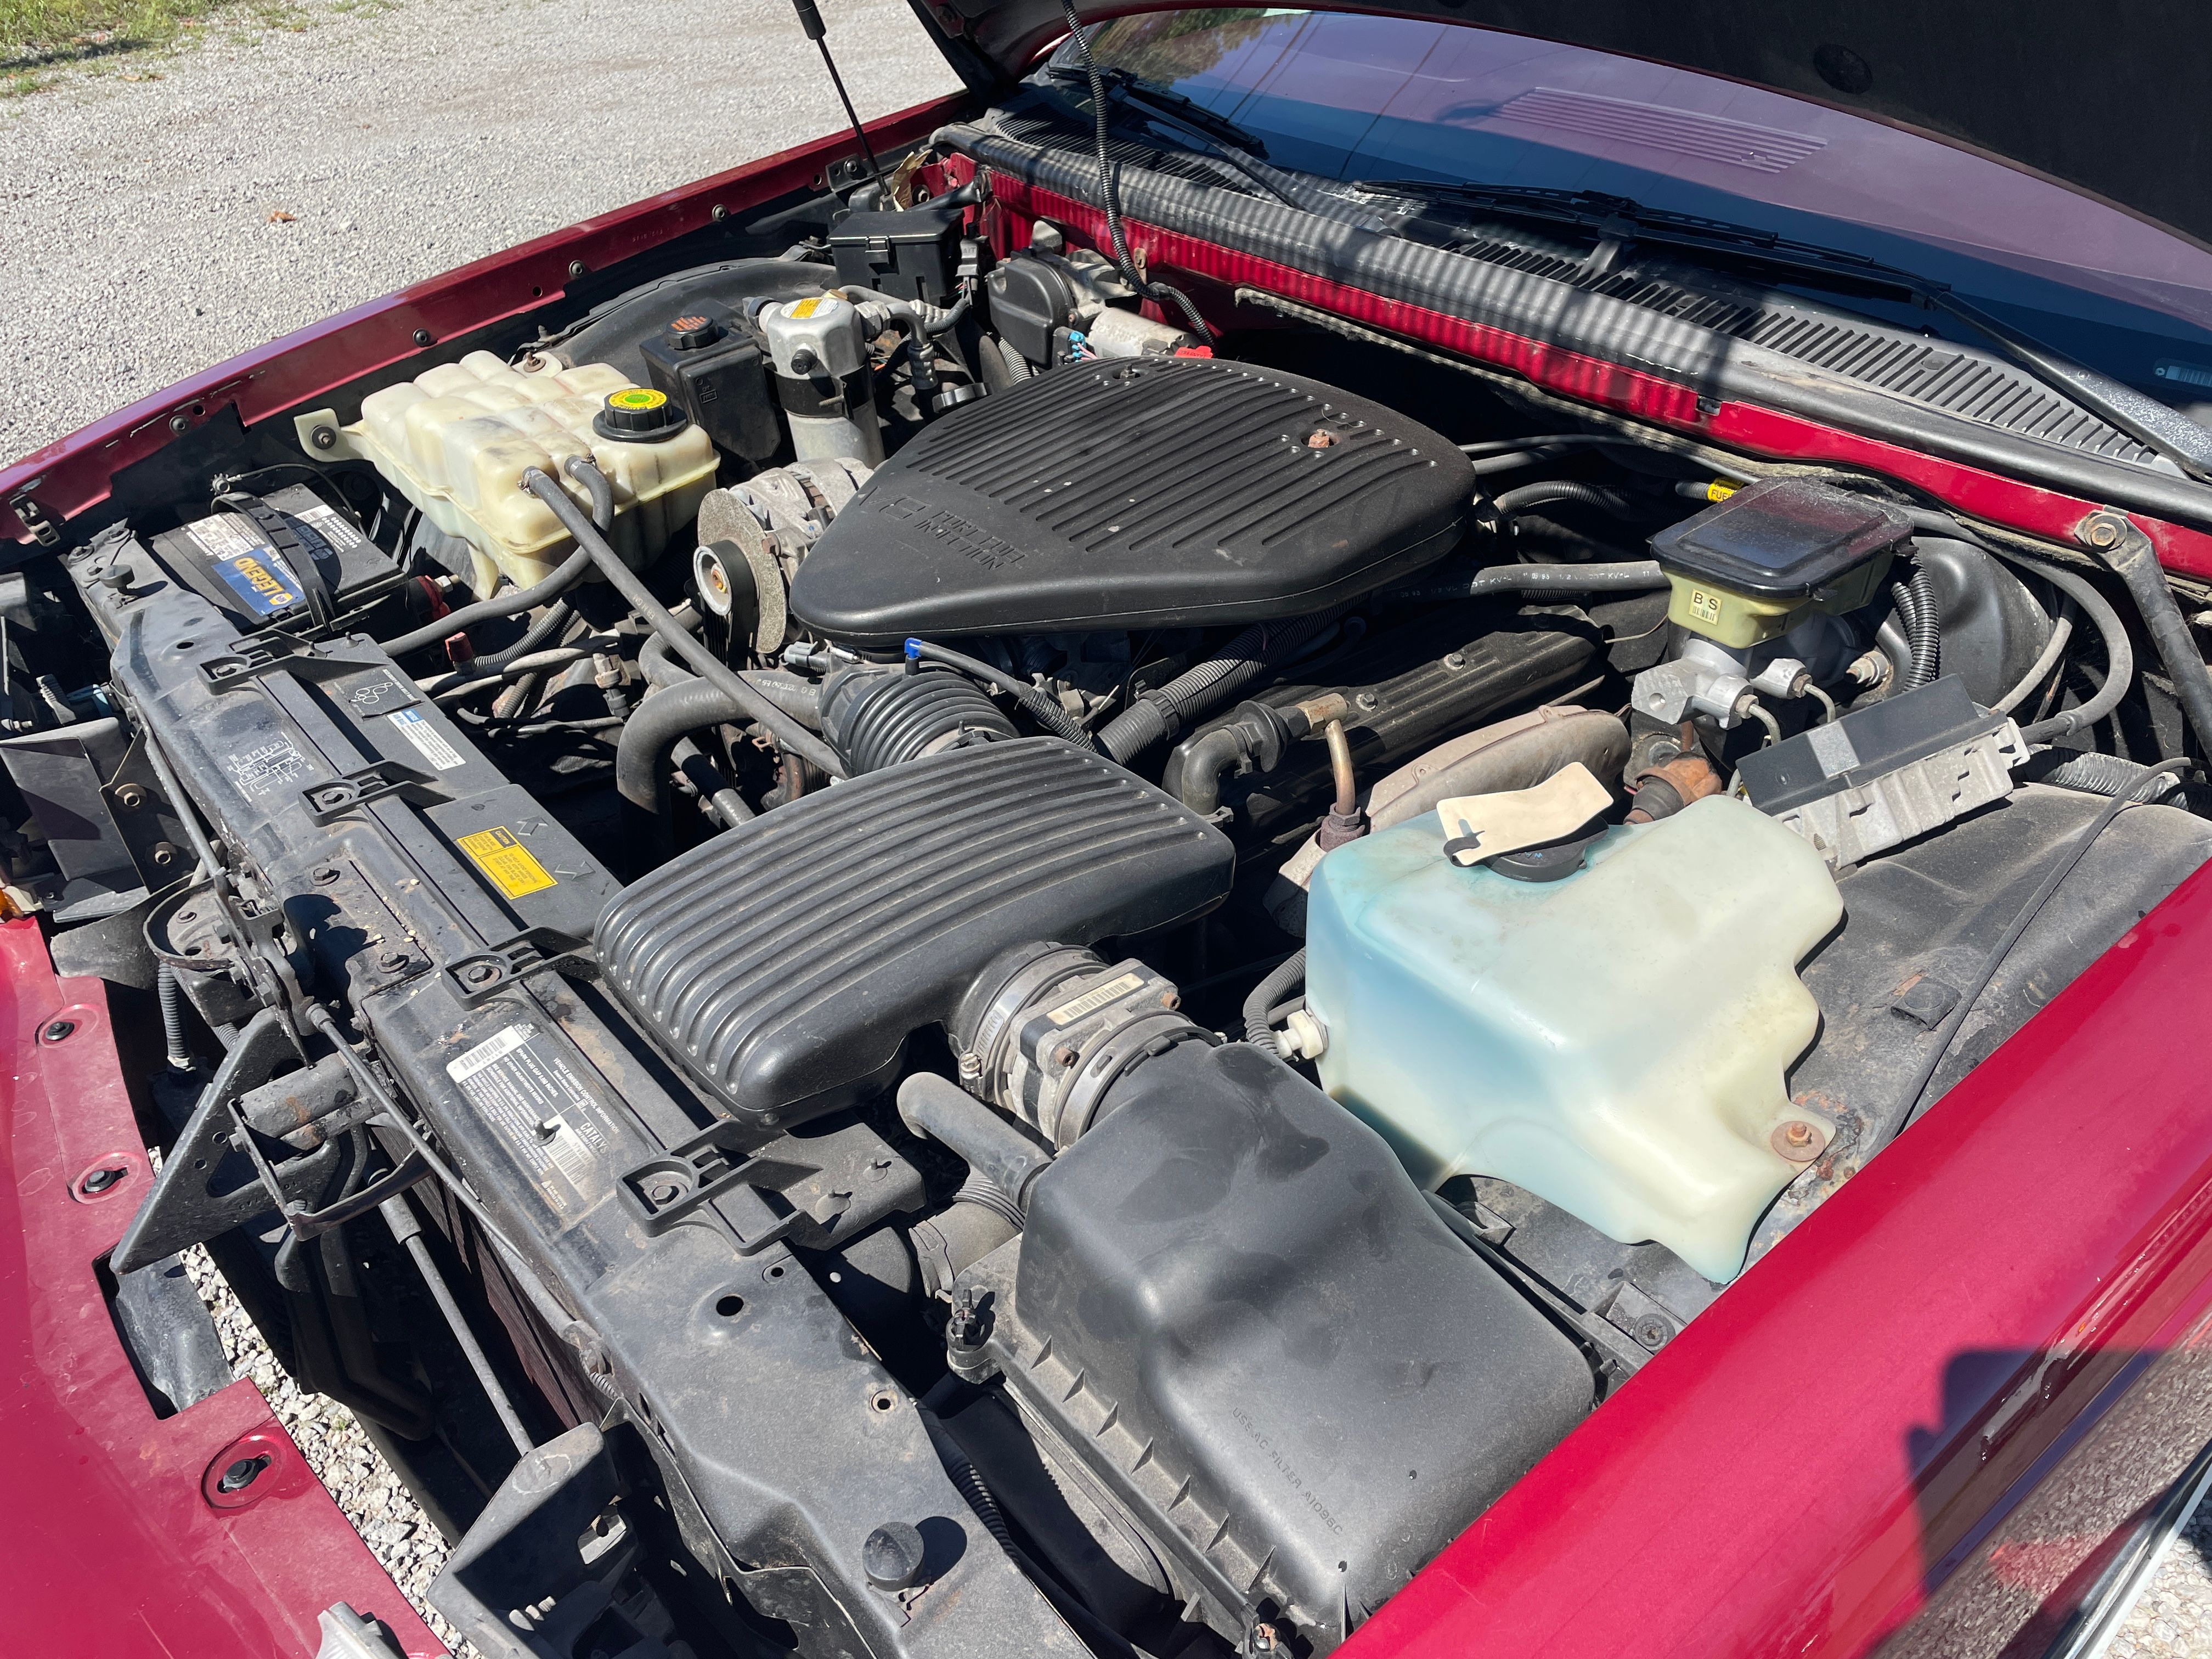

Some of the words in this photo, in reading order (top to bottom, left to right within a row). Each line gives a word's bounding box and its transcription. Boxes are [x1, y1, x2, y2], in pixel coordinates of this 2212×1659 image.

[913, 518, 1008, 571] INJECTION
[931, 510, 987, 537] PORT
[979, 535, 1028, 569] FUEL
[234, 557, 285, 597] LEGEND
[1694, 592, 1703, 604] B
[1708, 598, 1718, 610] S
[494, 831, 511, 844] CAUTION
[553, 1057, 569, 1075] VEHICLE
[566, 1071, 584, 1092] EMISSION
[580, 1090, 598, 1108] CONTROL
[595, 1105, 620, 1133] INFORMATION
[580, 1122, 608, 1154] CATALYS
[1232, 1407, 1253, 1432] USE
[1251, 1431, 1268, 1451] AC
[1268, 1451, 1302, 1489] FILTER
